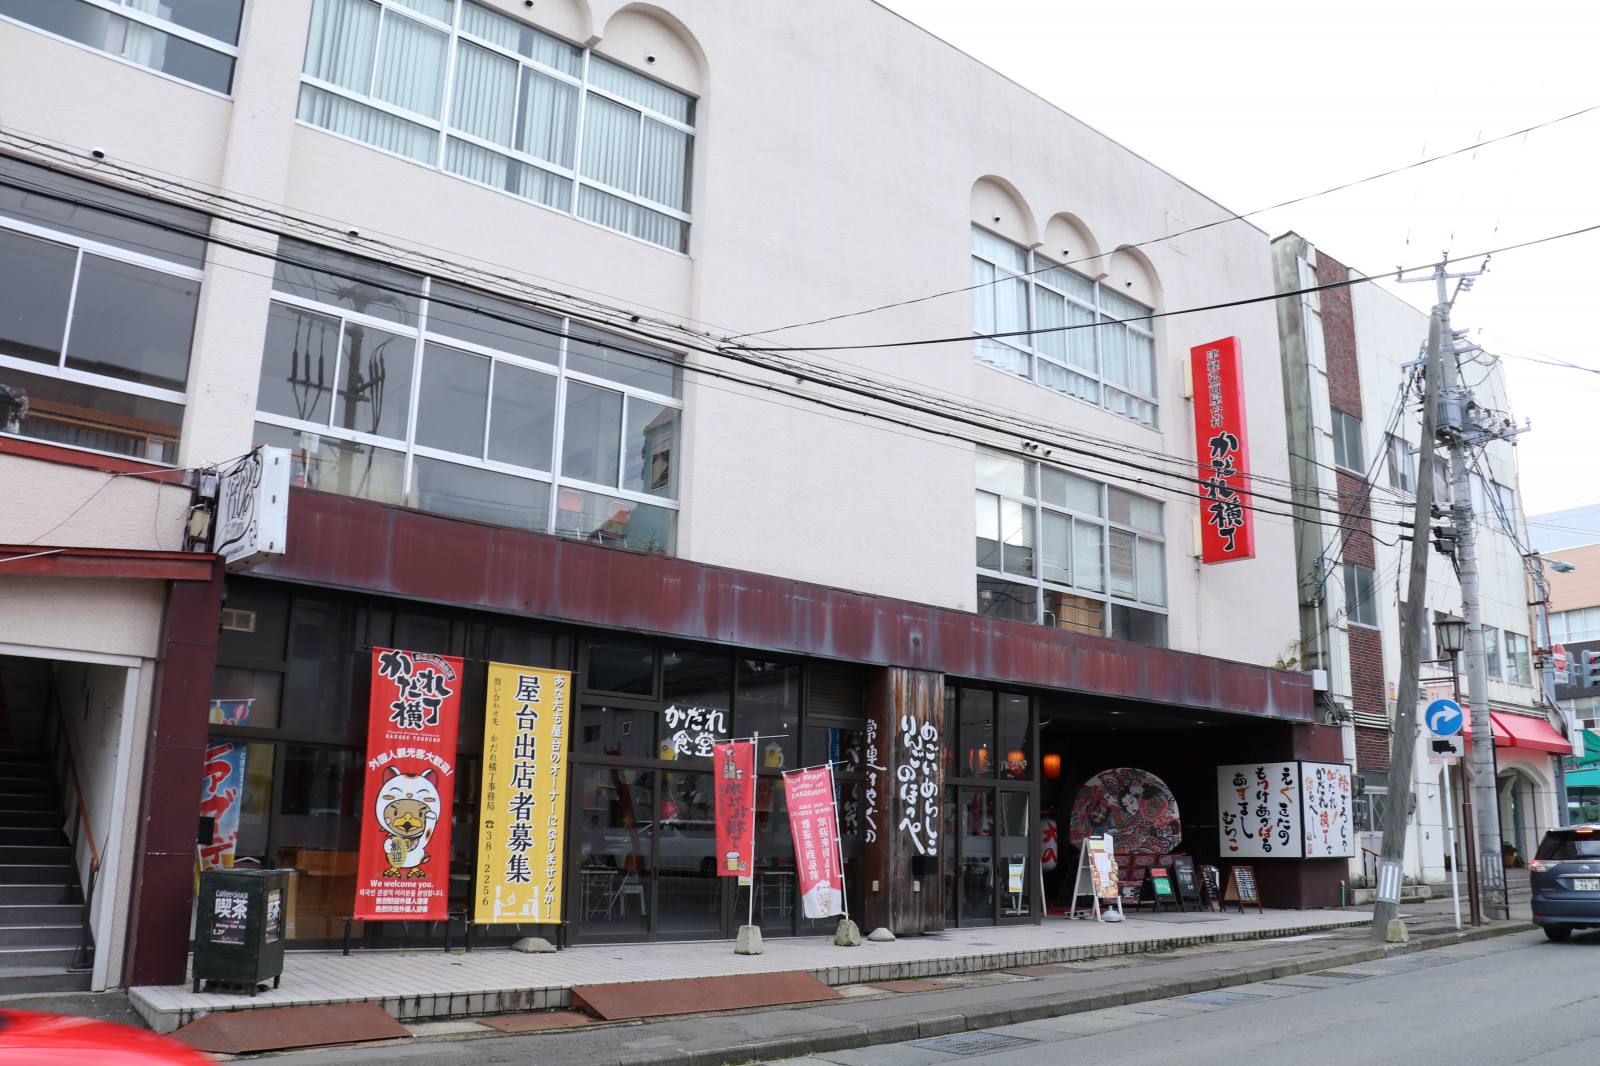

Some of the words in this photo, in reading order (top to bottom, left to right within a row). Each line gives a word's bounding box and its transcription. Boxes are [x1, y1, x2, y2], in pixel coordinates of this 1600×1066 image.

[1202, 432, 1244, 552] かだれ横丁
[378, 649, 453, 700] かだれ
[389, 697, 443, 730] 横丁
[664, 704, 727, 734] かだれ
[672, 730, 715, 757] 食堂
[505, 674, 541, 884] 屋台出店者募集
[897, 714, 925, 855] りんごのほっぺ
[920, 720, 939, 856] めごいめらしこ
[1222, 810, 1239, 852] むらこ
[370, 879, 382, 888] We
[384, 880, 417, 889] welcome
[418, 881, 434, 890] you.
[214, 898, 249, 920] 喫茶
